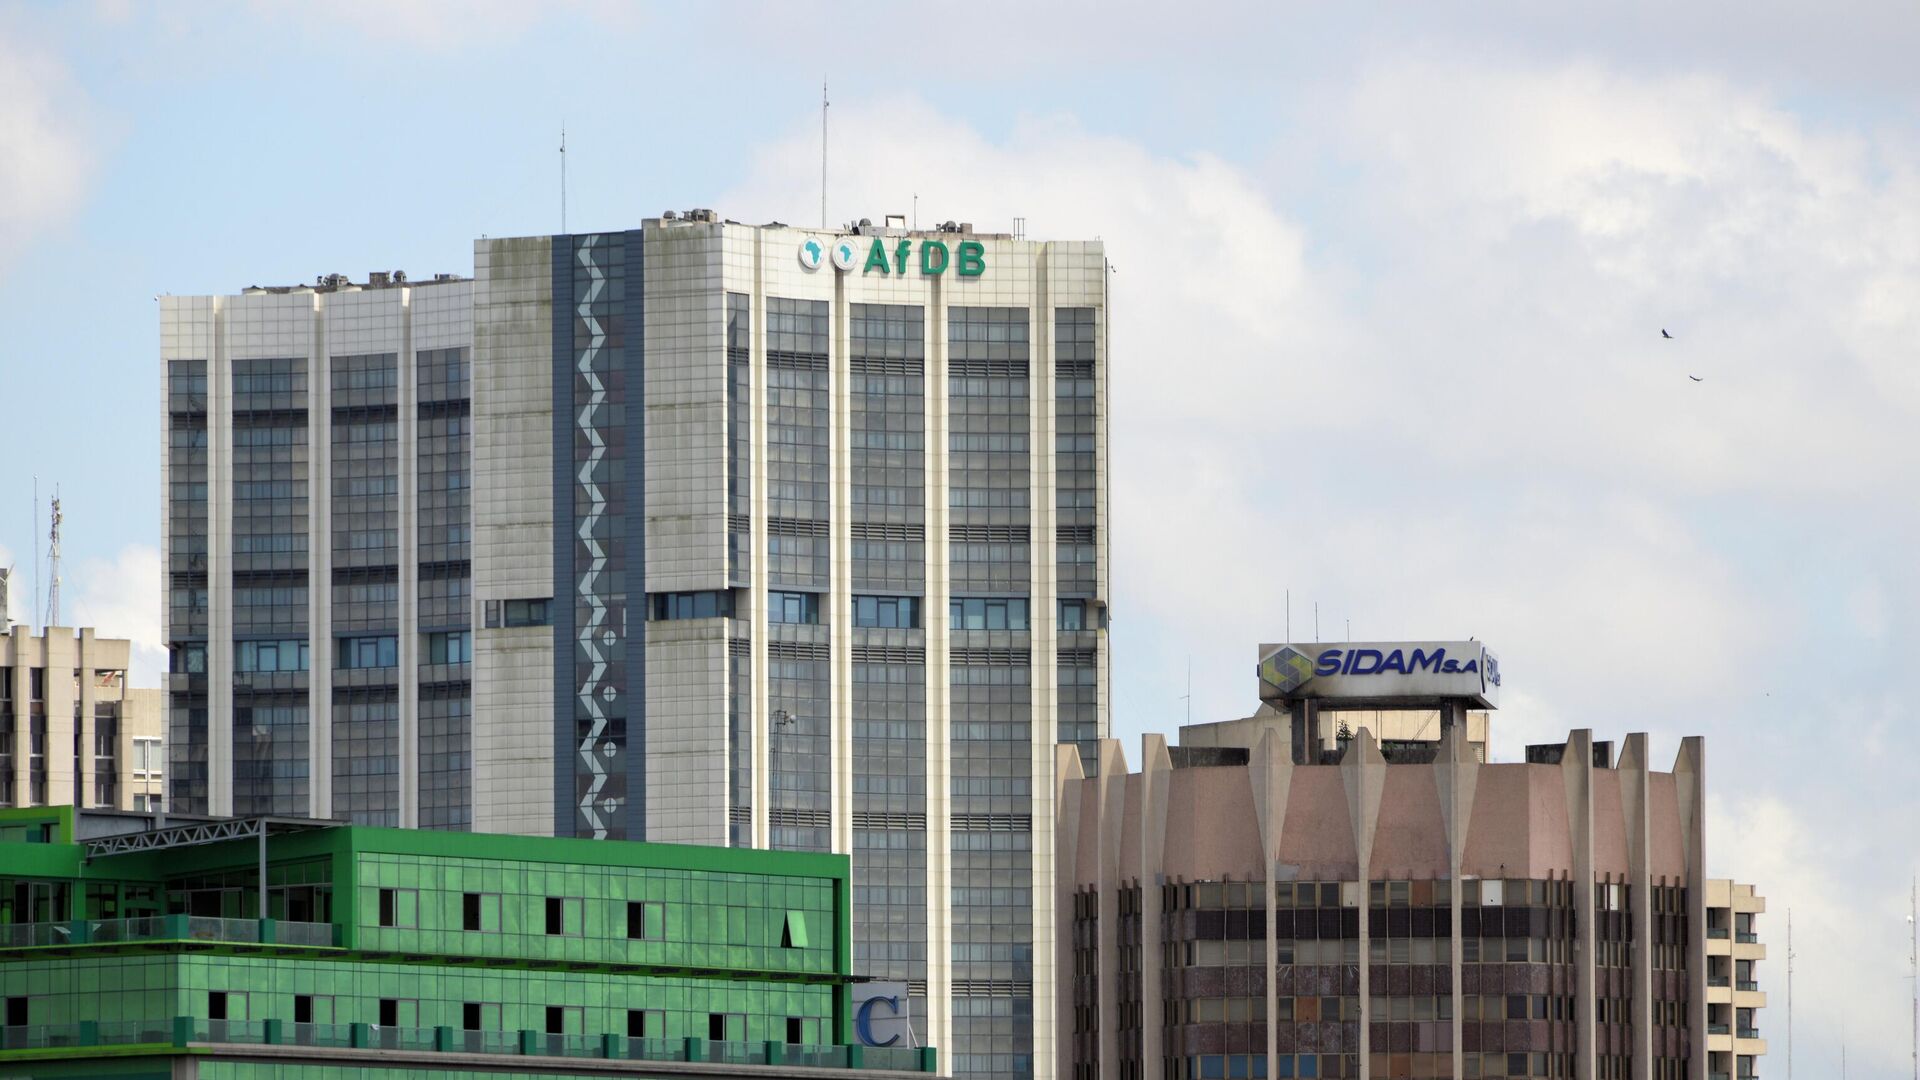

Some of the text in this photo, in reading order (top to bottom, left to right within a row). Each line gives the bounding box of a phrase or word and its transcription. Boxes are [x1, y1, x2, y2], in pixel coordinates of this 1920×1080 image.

[863, 239, 986, 276] AfDB
[1315, 648, 1446, 677] SIDAM
[856, 996, 900, 1047] C
